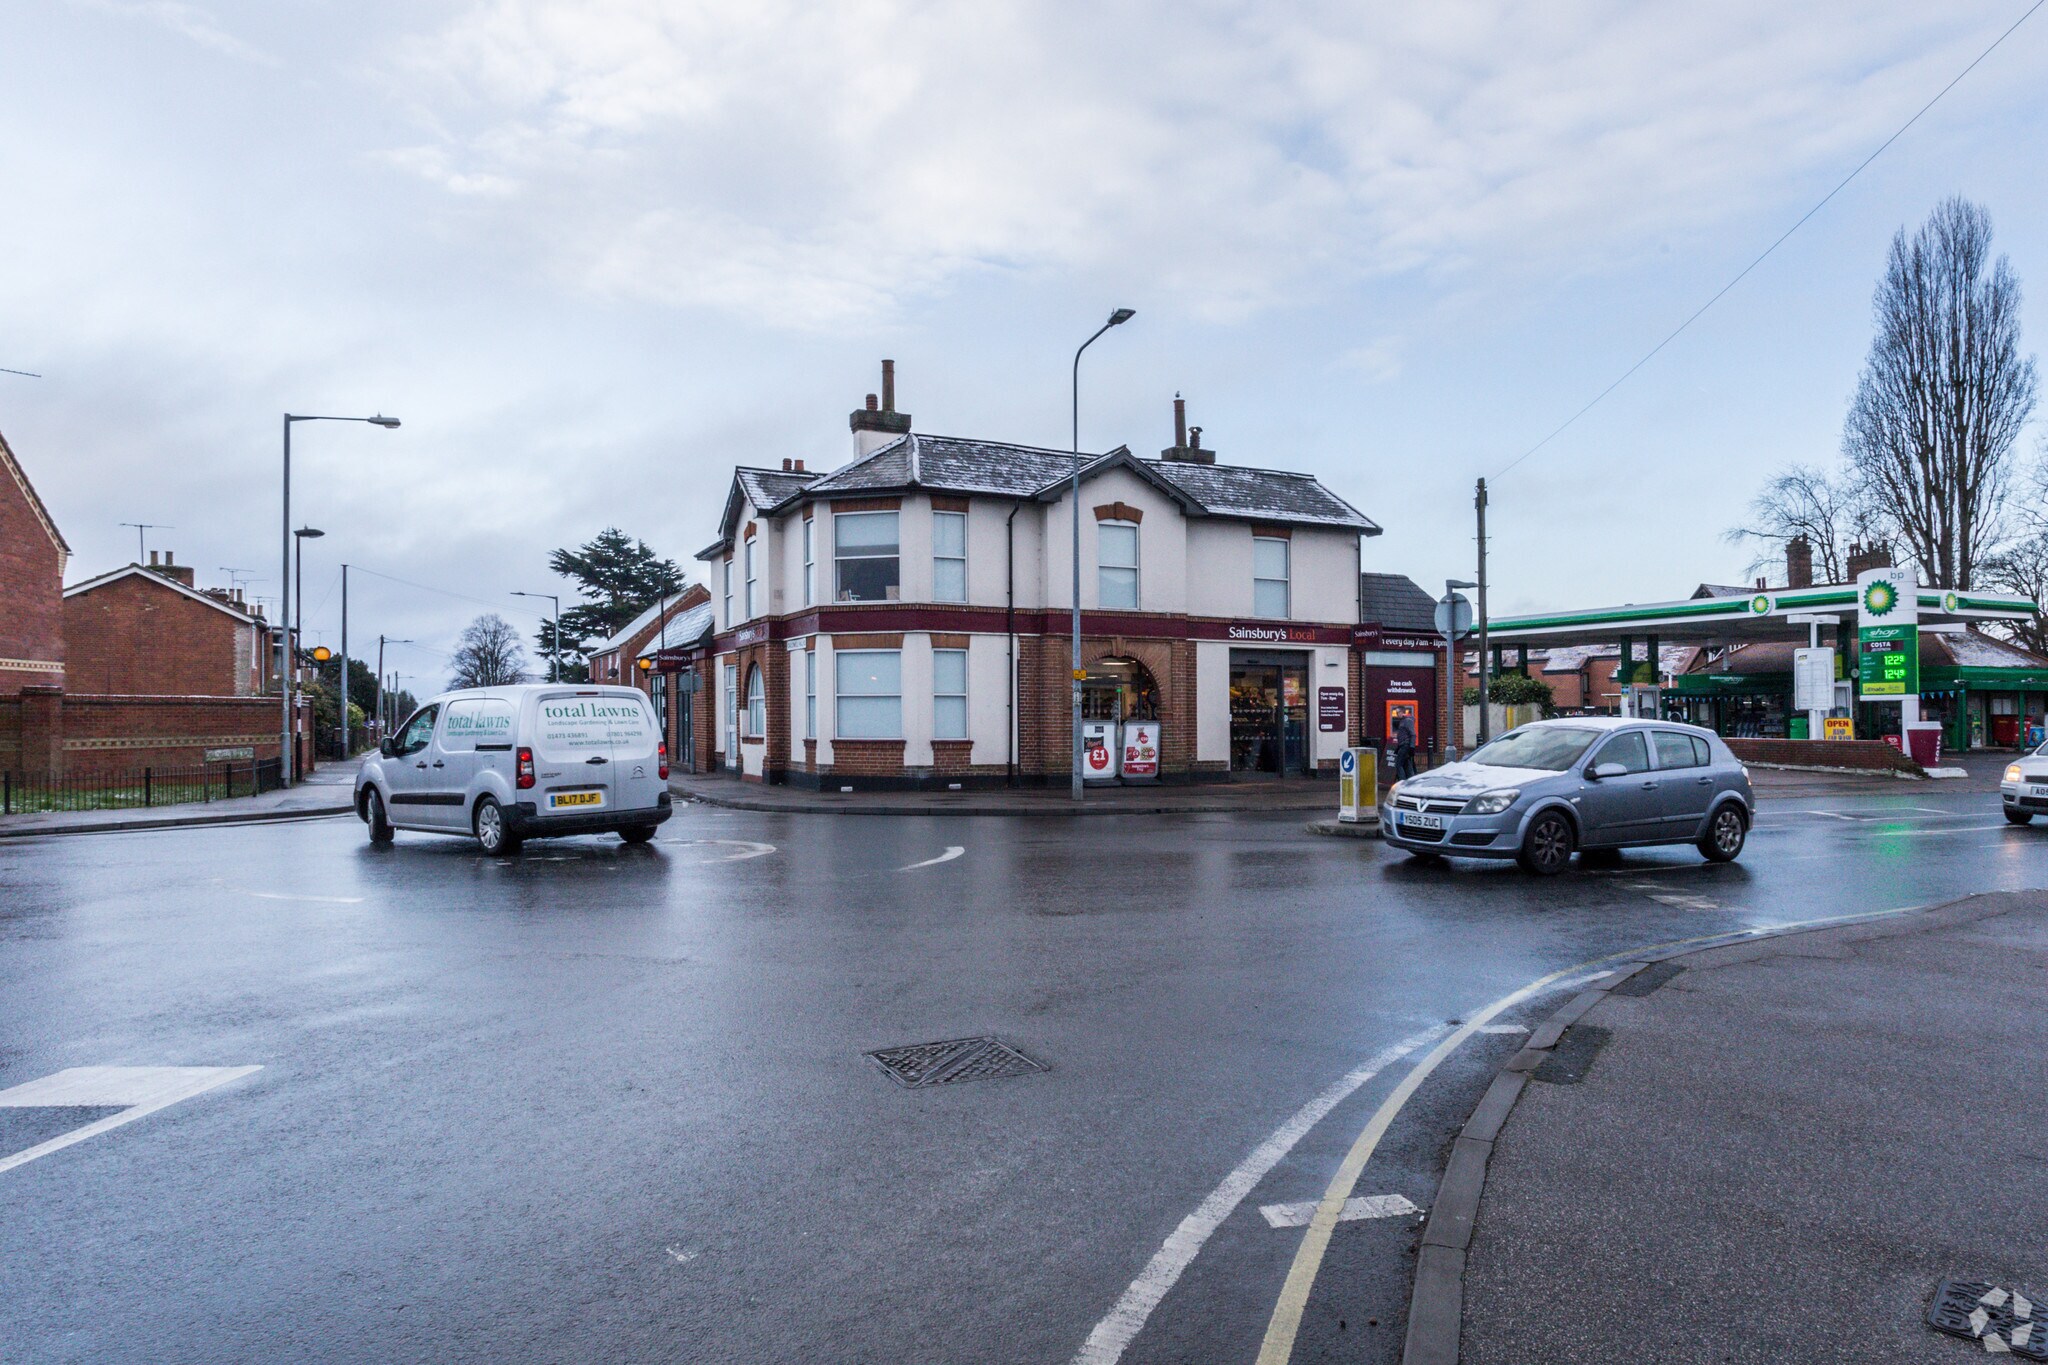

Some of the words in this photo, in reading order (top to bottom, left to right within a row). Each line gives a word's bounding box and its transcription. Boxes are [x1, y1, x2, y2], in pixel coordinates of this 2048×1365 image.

[1890, 571, 1904, 580] bp
[1229, 627, 1287, 642] Sainsbury's
[1289, 628, 1316, 641] Local
[1869, 628, 1899, 638] shop
[1385, 639, 1403, 647] every
[1403, 637, 1415, 648] day
[1415, 638, 1429, 646] 7am
[545, 703, 586, 718] total
[591, 703, 639, 718] lawns
[448, 711, 474, 729] total
[475, 711, 511, 729] lawns
[1827, 720, 1850, 728] OPEN
[1934, 734, 1942, 762] COSTA
[1092, 749, 1106, 761] £1
[557, 794, 577, 805] BL17
[580, 793, 597, 803] DJF
[1404, 814, 1422, 826] YS05
[1423, 816, 1439, 828] ZUC
